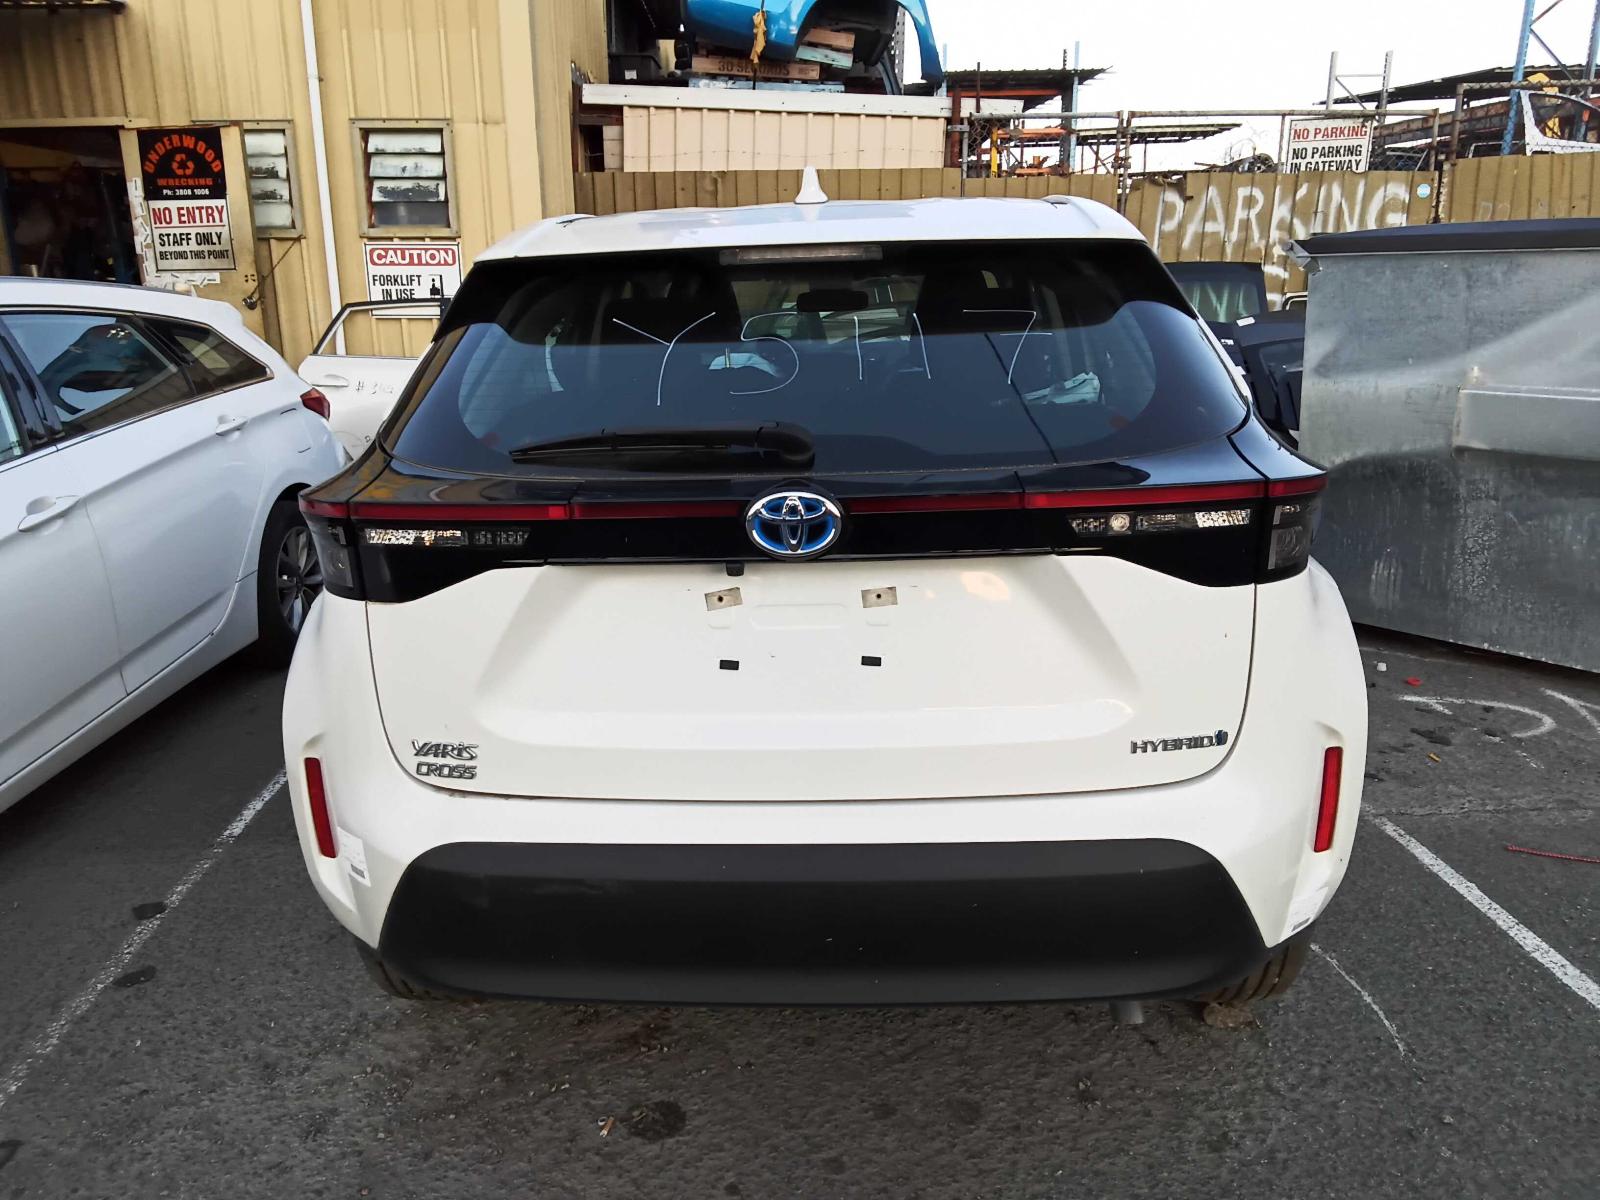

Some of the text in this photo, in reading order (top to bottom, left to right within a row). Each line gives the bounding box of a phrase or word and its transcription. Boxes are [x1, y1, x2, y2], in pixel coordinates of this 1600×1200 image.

[1293, 125, 1367, 140] NO PARKING
[143, 134, 222, 174] UNDERWOOD
[1292, 144, 1362, 160] NO PARKING
[1290, 159, 1362, 174] IN GATEWAY
[157, 178, 213, 186] WRECKING
[152, 205, 225, 225] NO ENTRY
[1153, 179, 1410, 252] PARKING
[158, 232, 222, 247] STAFF ONLY
[160, 249, 229, 261] BEYOND THIS POINT
[373, 249, 453, 264] CAUTION
[372, 275, 422, 286] FORKLIFT
[382, 288, 416, 300] IN USE
[1130, 735, 1214, 754] HYBRID
[416, 761, 478, 779] CROSS
